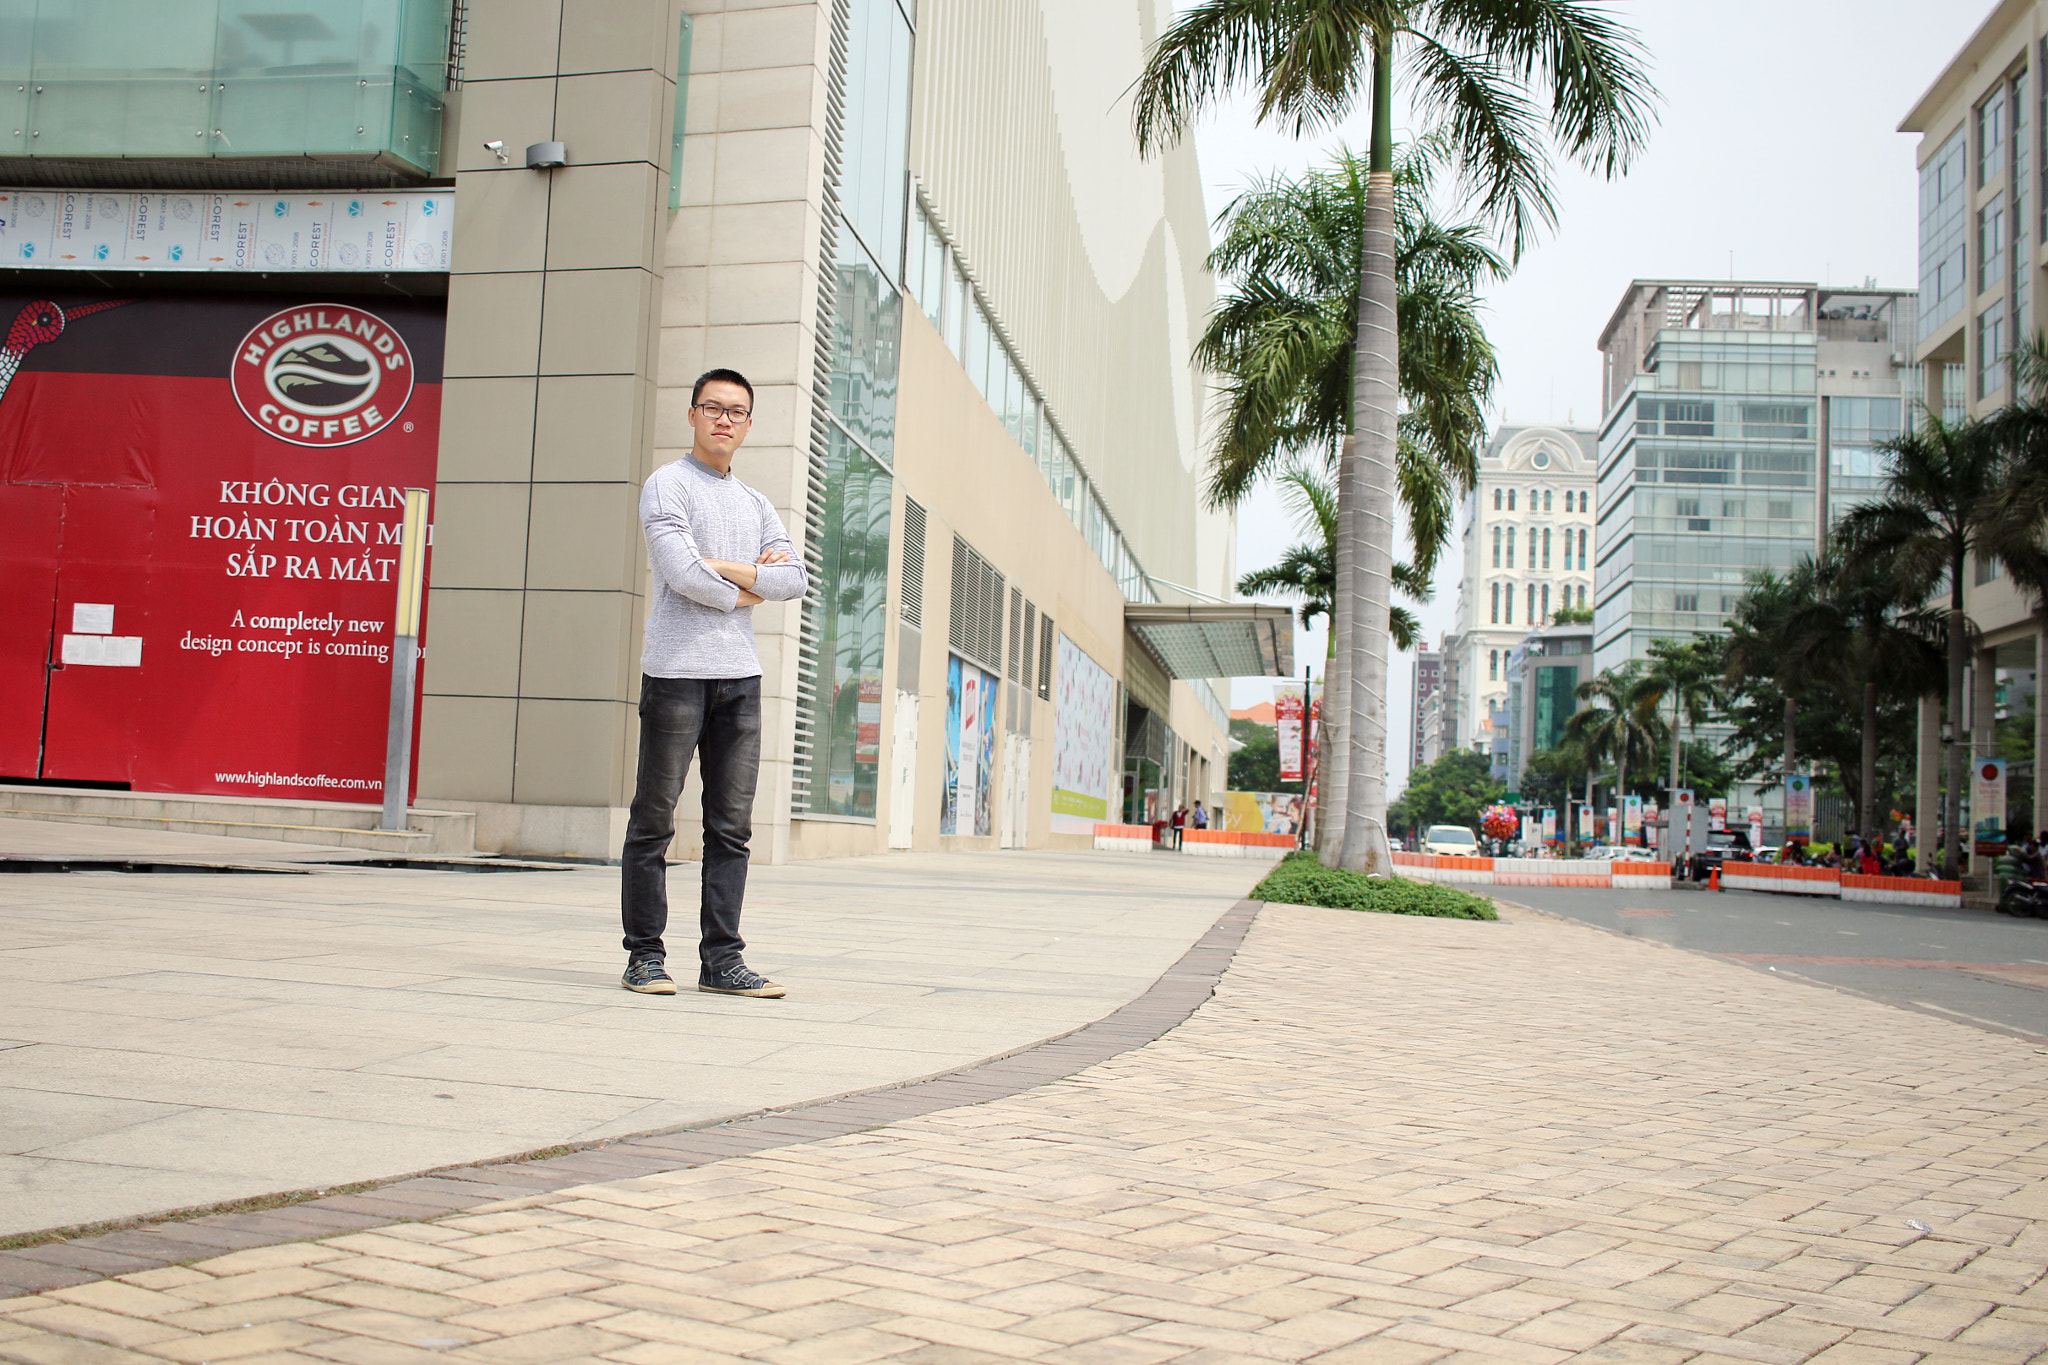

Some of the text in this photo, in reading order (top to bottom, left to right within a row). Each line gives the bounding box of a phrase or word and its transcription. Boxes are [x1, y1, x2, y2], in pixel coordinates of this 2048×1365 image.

[62, 192, 75, 240] COREST
[136, 194, 149, 241] COREST
[210, 194, 223, 242] COREST
[236, 221, 248, 269] COREST
[309, 221, 322, 269] COREST
[384, 221, 397, 269] COREST
[243, 311, 405, 371] HIGHLANDS
[259, 403, 384, 439] COFFEE
[219, 477, 407, 509] KHÔNG GIAN
[189, 510, 435, 547] HOÀN TOÀN MI
[226, 543, 397, 582] SẮP RA MẮT
[230, 609, 385, 637] A completely new
[180, 630, 233, 657] design
[237, 639, 304, 660] concept
[307, 638, 321, 655] is
[325, 640, 390, 664] coming
[214, 771, 383, 790] www.highlandscoffee.com.vn
